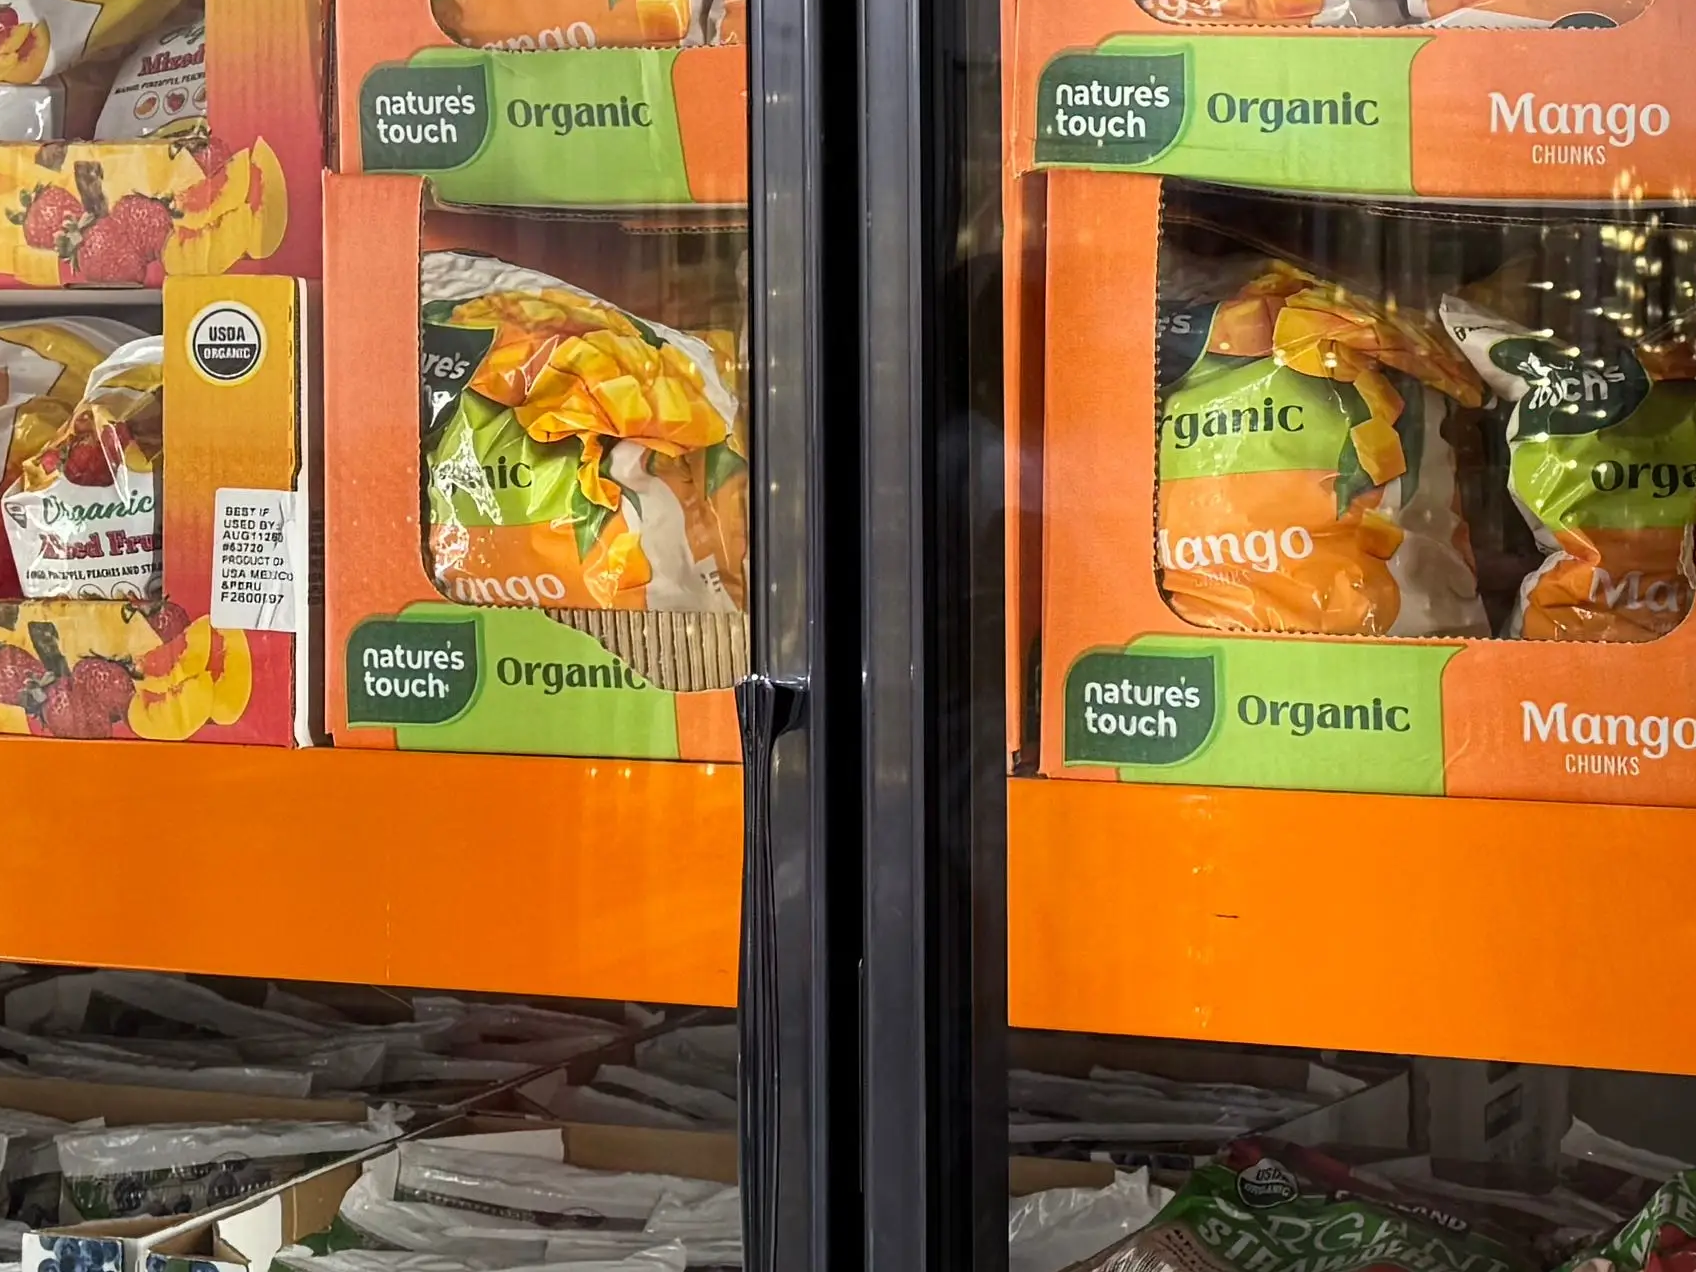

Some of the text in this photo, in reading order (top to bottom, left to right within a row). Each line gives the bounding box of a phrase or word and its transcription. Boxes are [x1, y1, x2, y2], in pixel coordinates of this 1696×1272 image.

[376, 84, 475, 116] nature's
[1055, 76, 1170, 110] nature's
[507, 97, 652, 143] Organic
[1057, 108, 1146, 139] touch
[1207, 92, 1379, 134] Organic
[1489, 91, 1670, 147] Mango
[377, 119, 456, 144] touch
[1532, 142, 1606, 165] CHUNKS
[208, 326, 246, 342] USDA
[203, 346, 250, 360] ORGANIC
[222, 569, 246, 578] USA
[1084, 677, 1200, 710] nature's
[1086, 708, 1178, 739] touch
[1238, 695, 1410, 737] Organic
[1566, 752, 1640, 776] CHUNKS
